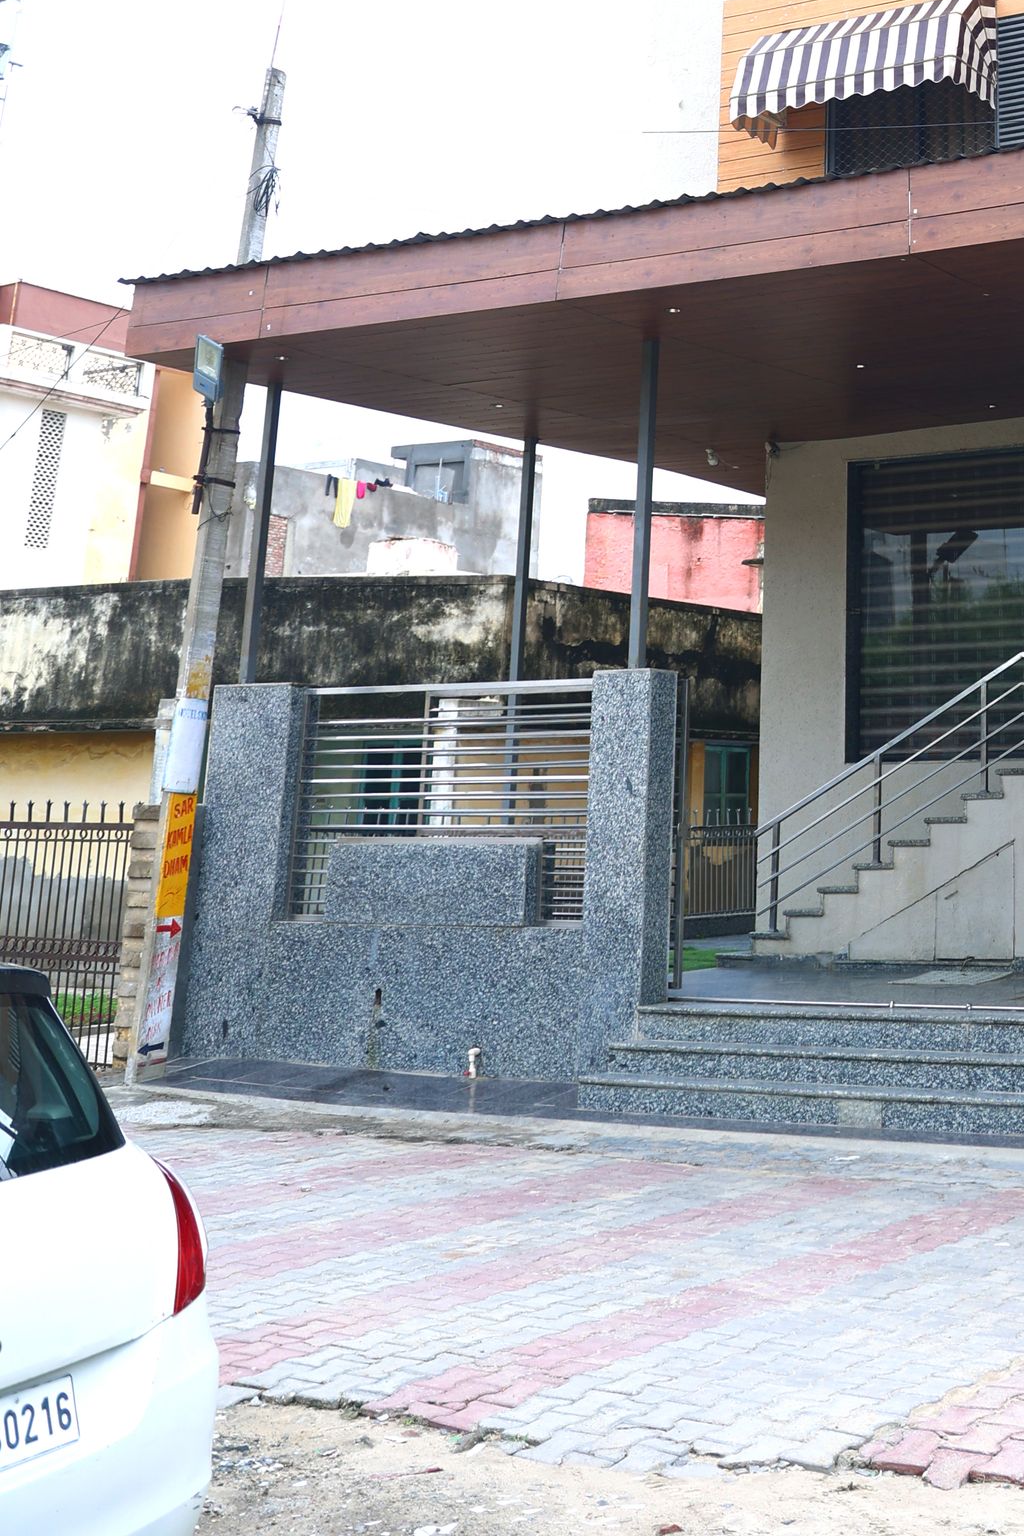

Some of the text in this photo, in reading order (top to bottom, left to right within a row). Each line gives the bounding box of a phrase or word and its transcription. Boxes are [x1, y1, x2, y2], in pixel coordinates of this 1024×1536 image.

[174, 797, 194, 819] SAR
[166, 824, 193, 850] KAMLA
[163, 854, 189, 879] DHAM
[0, 1392, 72, 1450] 0216
